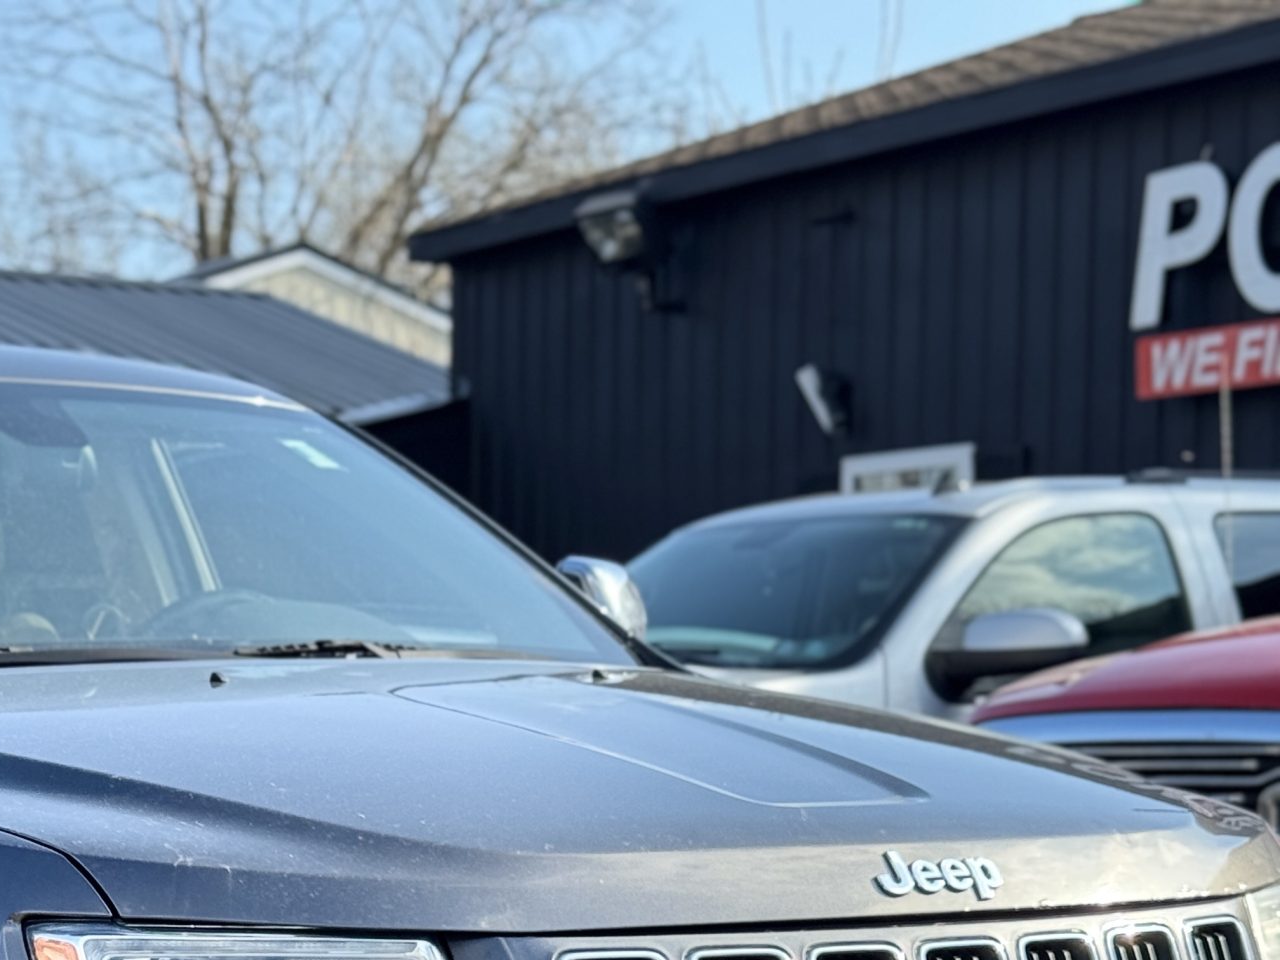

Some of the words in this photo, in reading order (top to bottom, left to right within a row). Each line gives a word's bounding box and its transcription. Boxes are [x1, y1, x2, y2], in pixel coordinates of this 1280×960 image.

[1150, 331, 1224, 393] WE
[1232, 325, 1280, 383] FI
[872, 850, 1004, 901] Jeep
